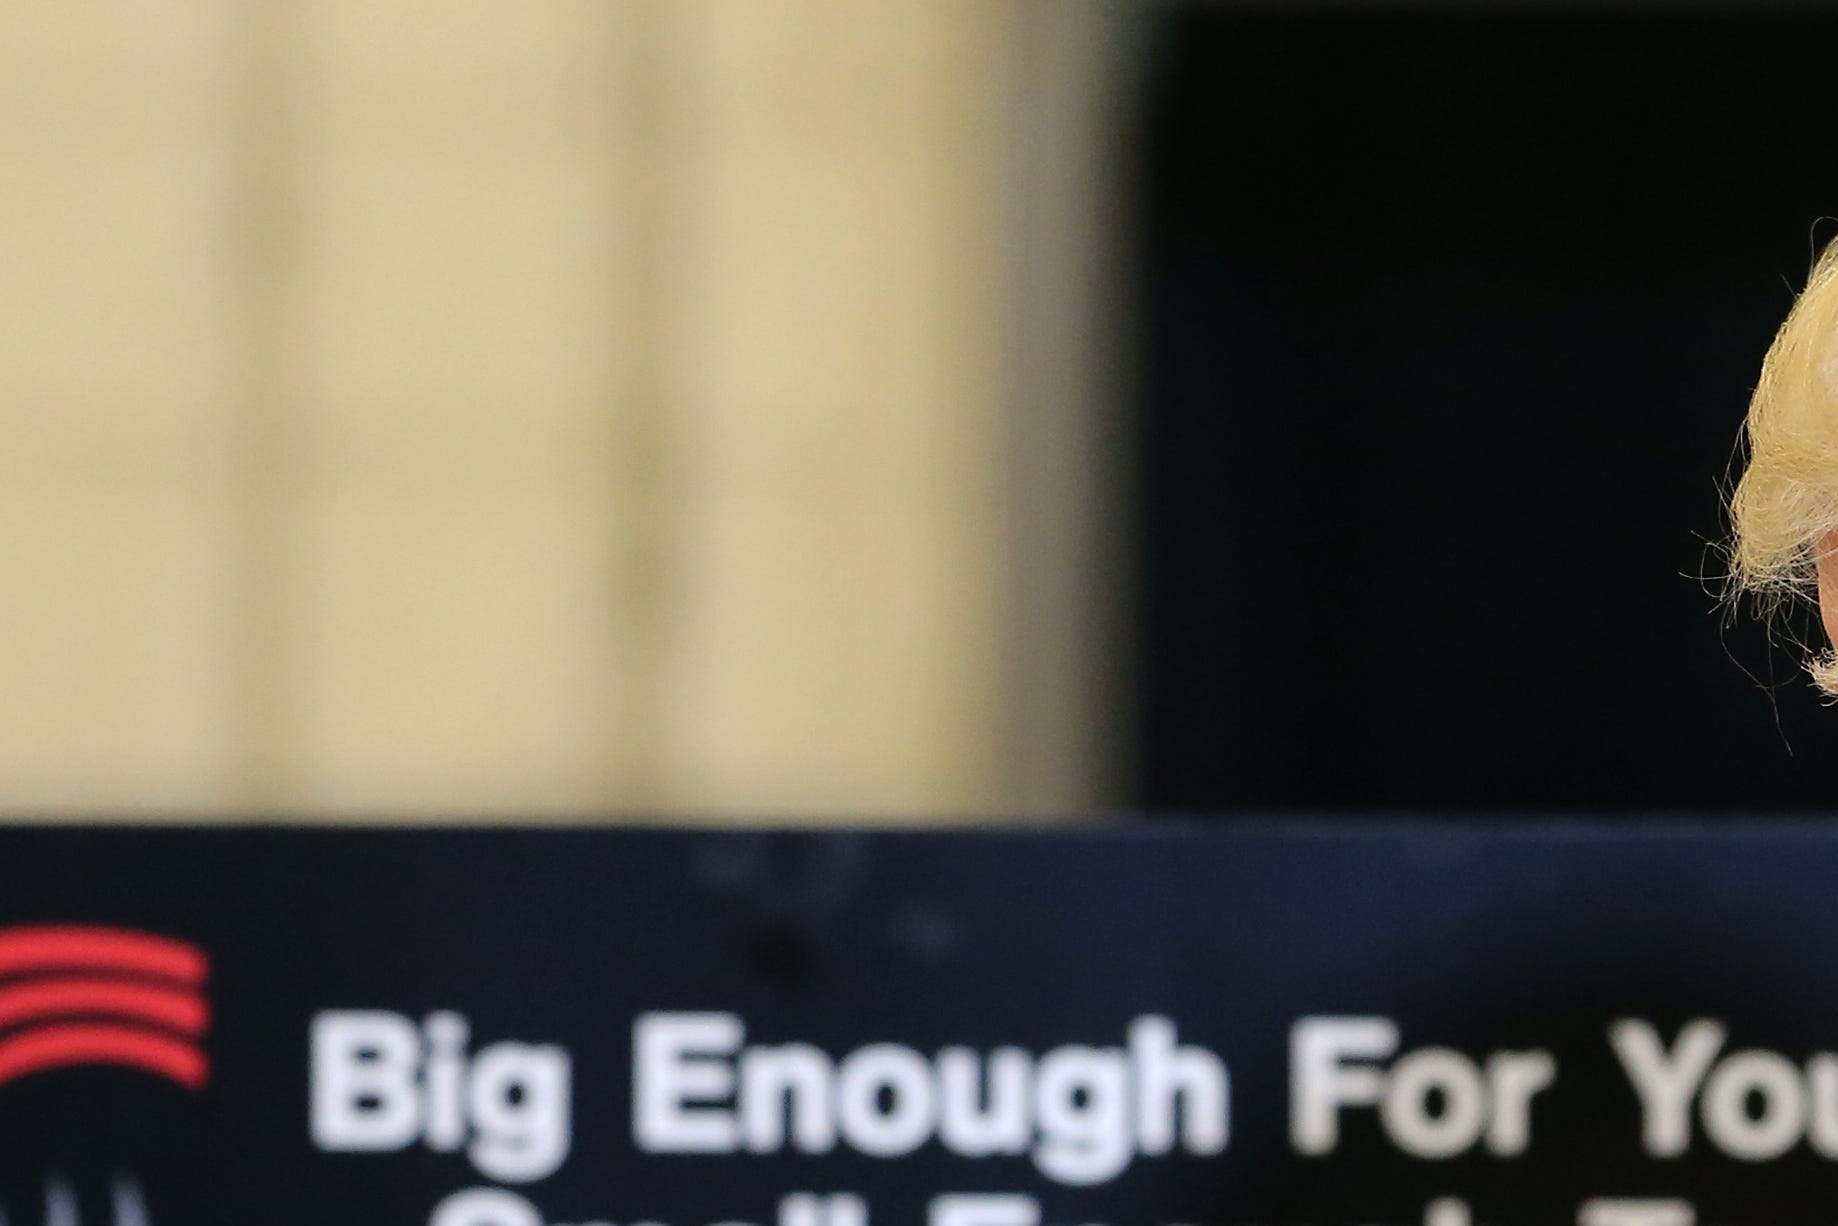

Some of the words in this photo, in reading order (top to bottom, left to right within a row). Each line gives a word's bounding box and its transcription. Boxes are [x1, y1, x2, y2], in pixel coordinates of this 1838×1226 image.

[309, 1009, 571, 1182] Big
[632, 1011, 1229, 1184] Enough
[1289, 1015, 1555, 1158] For
